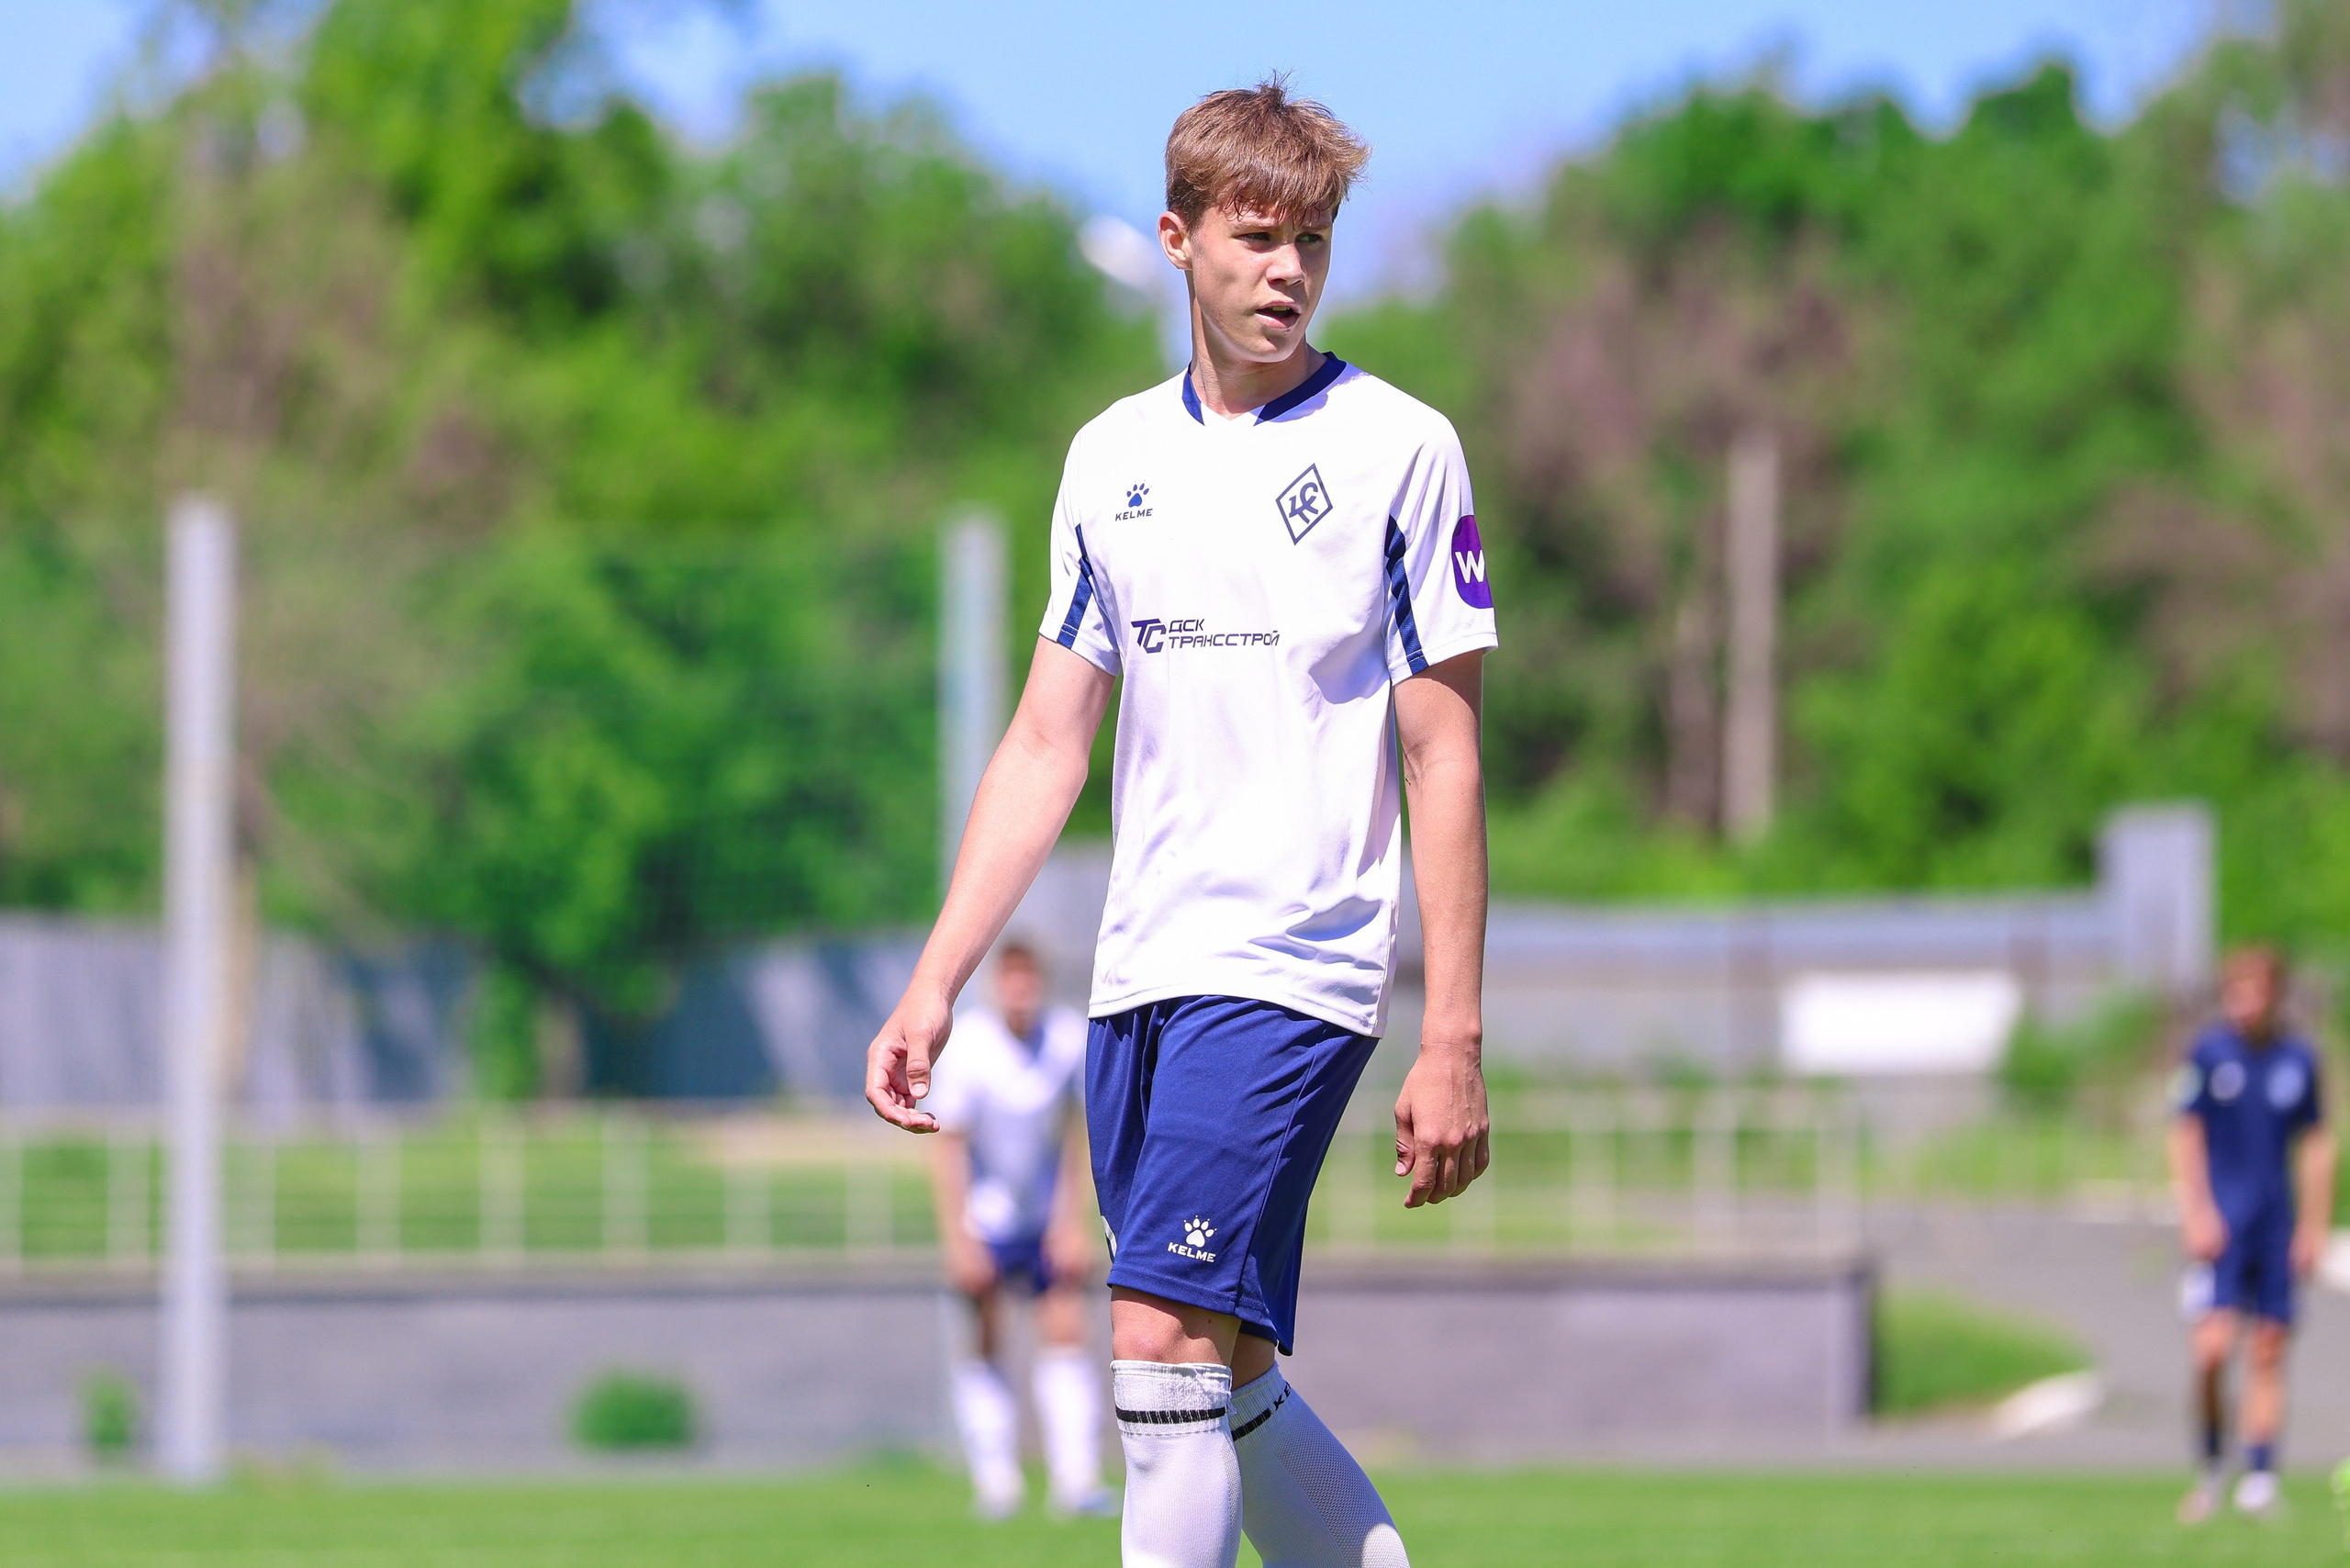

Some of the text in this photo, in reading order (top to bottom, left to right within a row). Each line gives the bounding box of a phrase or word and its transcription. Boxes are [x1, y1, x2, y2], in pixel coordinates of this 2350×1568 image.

[1114, 509, 1153, 521] KELME
[1454, 549, 1485, 584] W
[1169, 618, 1205, 633] ДСК
[1169, 630, 1281, 649] ТРАНССТРОЙ
[1167, 1241, 1216, 1263] KELME
[1273, 1381, 1292, 1411] KE
